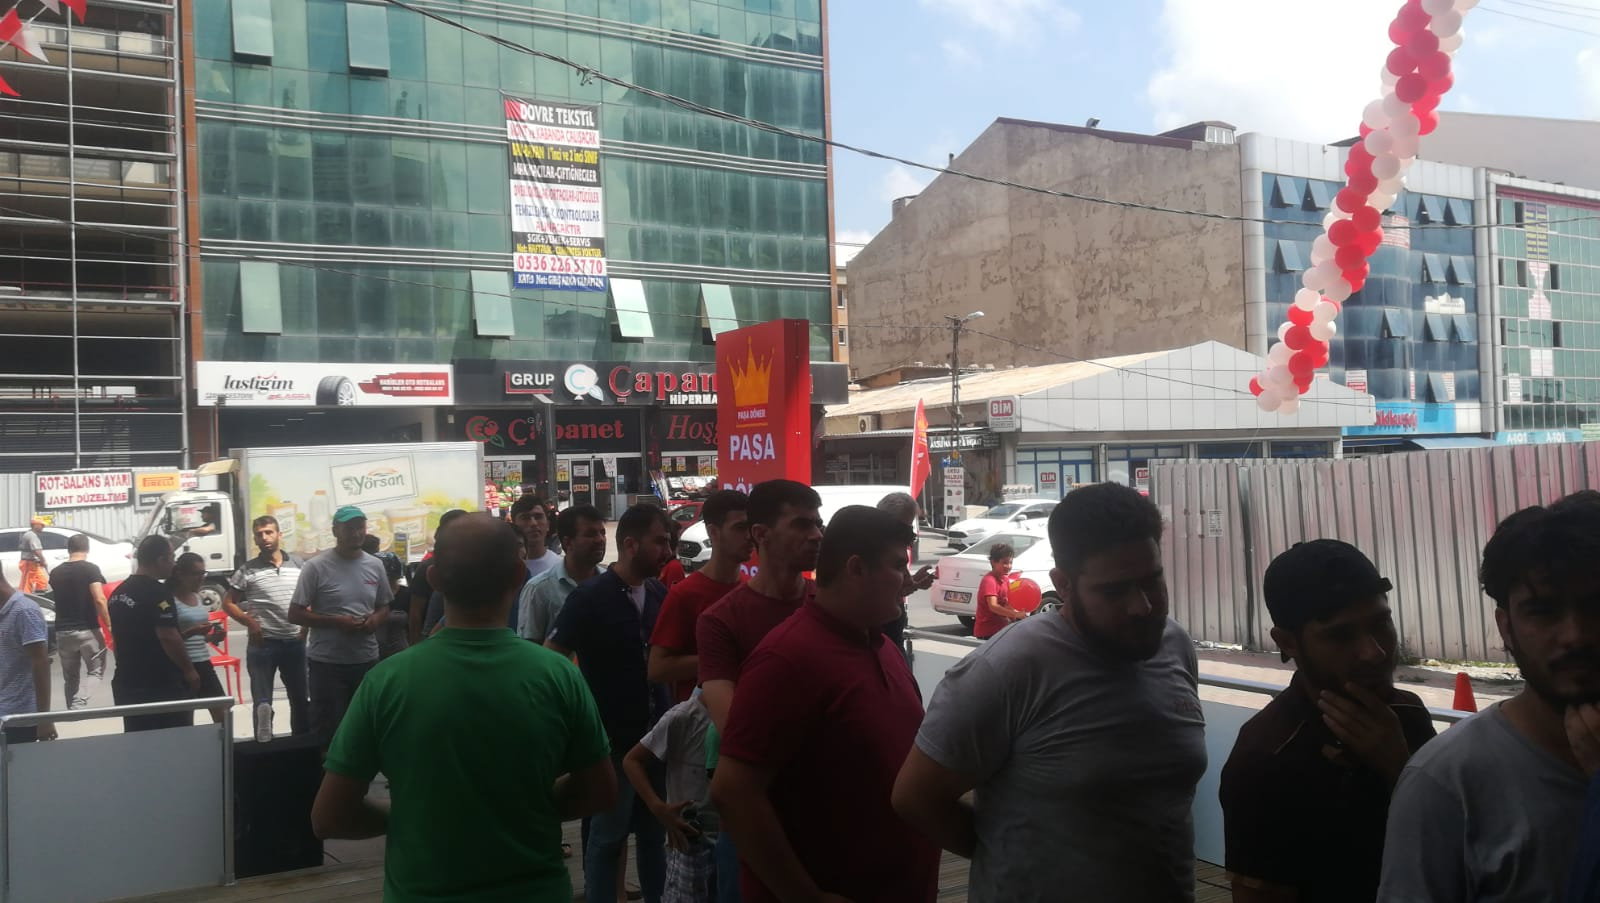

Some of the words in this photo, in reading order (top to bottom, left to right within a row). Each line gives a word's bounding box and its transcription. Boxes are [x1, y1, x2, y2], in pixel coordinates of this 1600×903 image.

[520, 104, 554, 123] DOVRE
[556, 108, 594, 127] TEKSTİL
[518, 255, 547, 271] 0536
[550, 257, 571, 273] 226
[589, 260, 603, 275] 70
[511, 373, 555, 386] GRUP
[608, 365, 718, 404] Çapan
[669, 392, 718, 405] HİPERMA
[666, 414, 718, 446] Hoş
[730, 432, 776, 465] PAŞA
[39, 474, 101, 491] ROT-BALANS
[103, 472, 131, 488] AYARI
[353, 473, 405, 495] Yörsan
[47, 494, 73, 505] JANT
[76, 491, 128, 504] DÜZELTME
